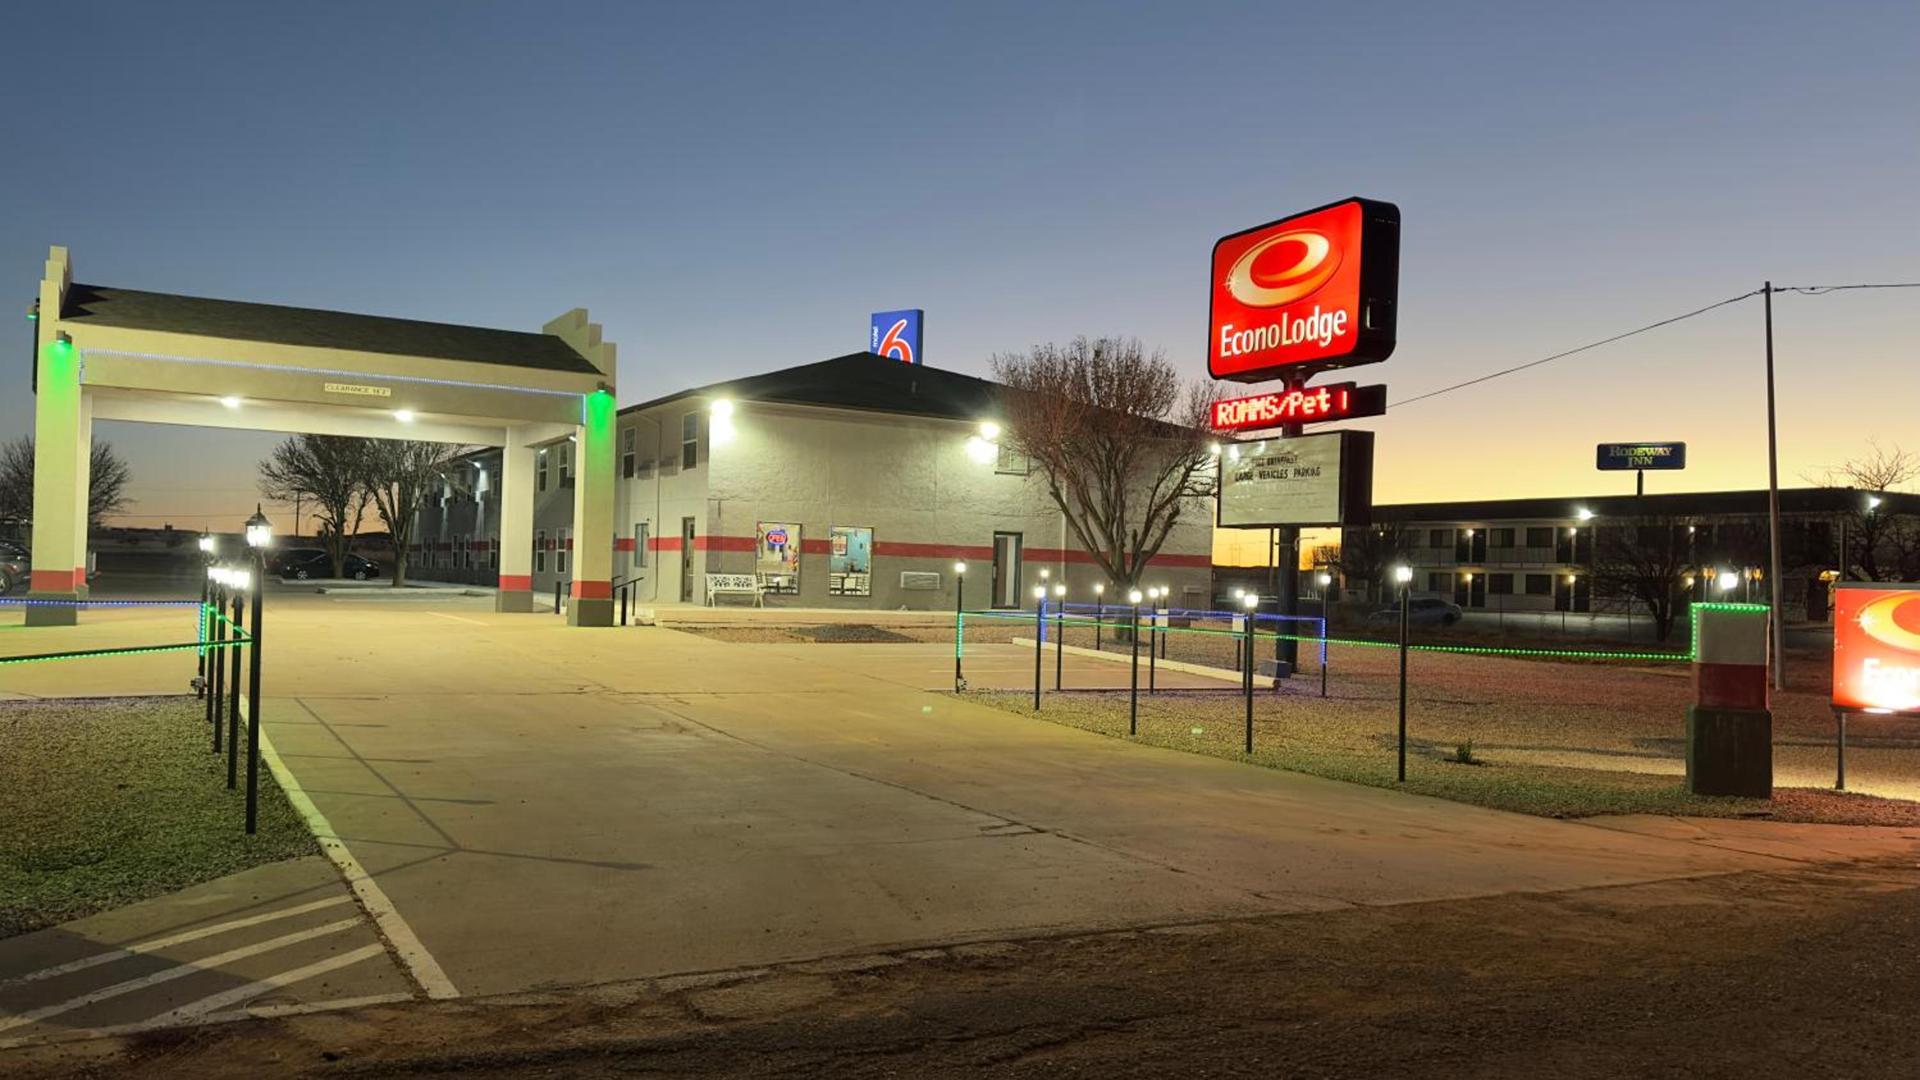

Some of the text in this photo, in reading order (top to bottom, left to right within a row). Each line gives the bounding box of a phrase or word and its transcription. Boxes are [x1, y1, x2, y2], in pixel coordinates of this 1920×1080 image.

[878, 319, 913, 363] 6
[1220, 305, 1347, 357] EconoLodge
[1628, 456, 1653, 467] INN
